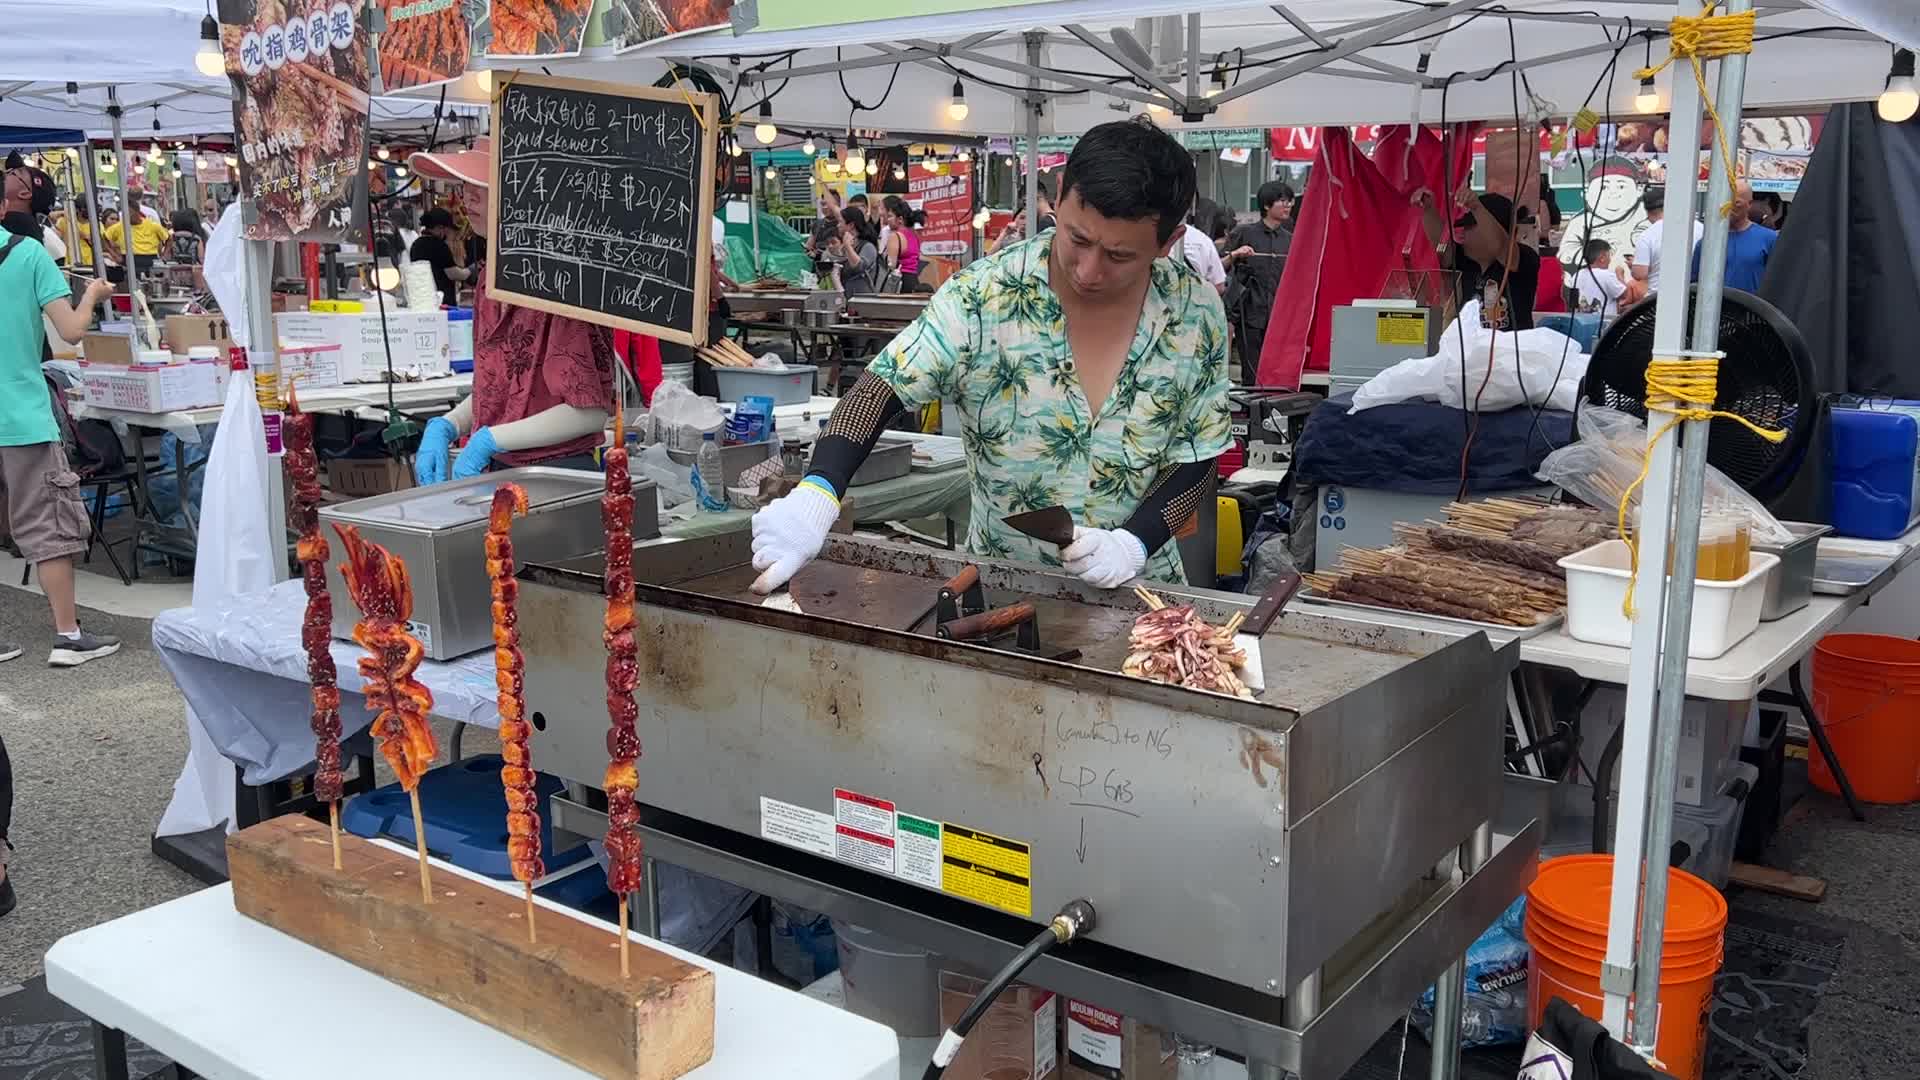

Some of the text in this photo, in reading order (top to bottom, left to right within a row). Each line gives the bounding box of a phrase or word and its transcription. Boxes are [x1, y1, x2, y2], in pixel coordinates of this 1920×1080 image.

[243, 10, 352, 69] 吮指鸡骨架
[505, 89, 600, 132] 铁板鱿鱼
[607, 109, 621, 127] 2
[654, 107, 691, 154] $25
[502, 125, 545, 156] Squid
[520, 257, 572, 300] Pick up
[610, 276, 664, 313] order
[361, 327, 409, 336] Compstable
[419, 334, 432, 347] 12
[1058, 765, 1098, 799] LP
[1070, 1000, 1095, 1017] MOULIN
[1094, 1009, 1119, 1029] ROUGE
